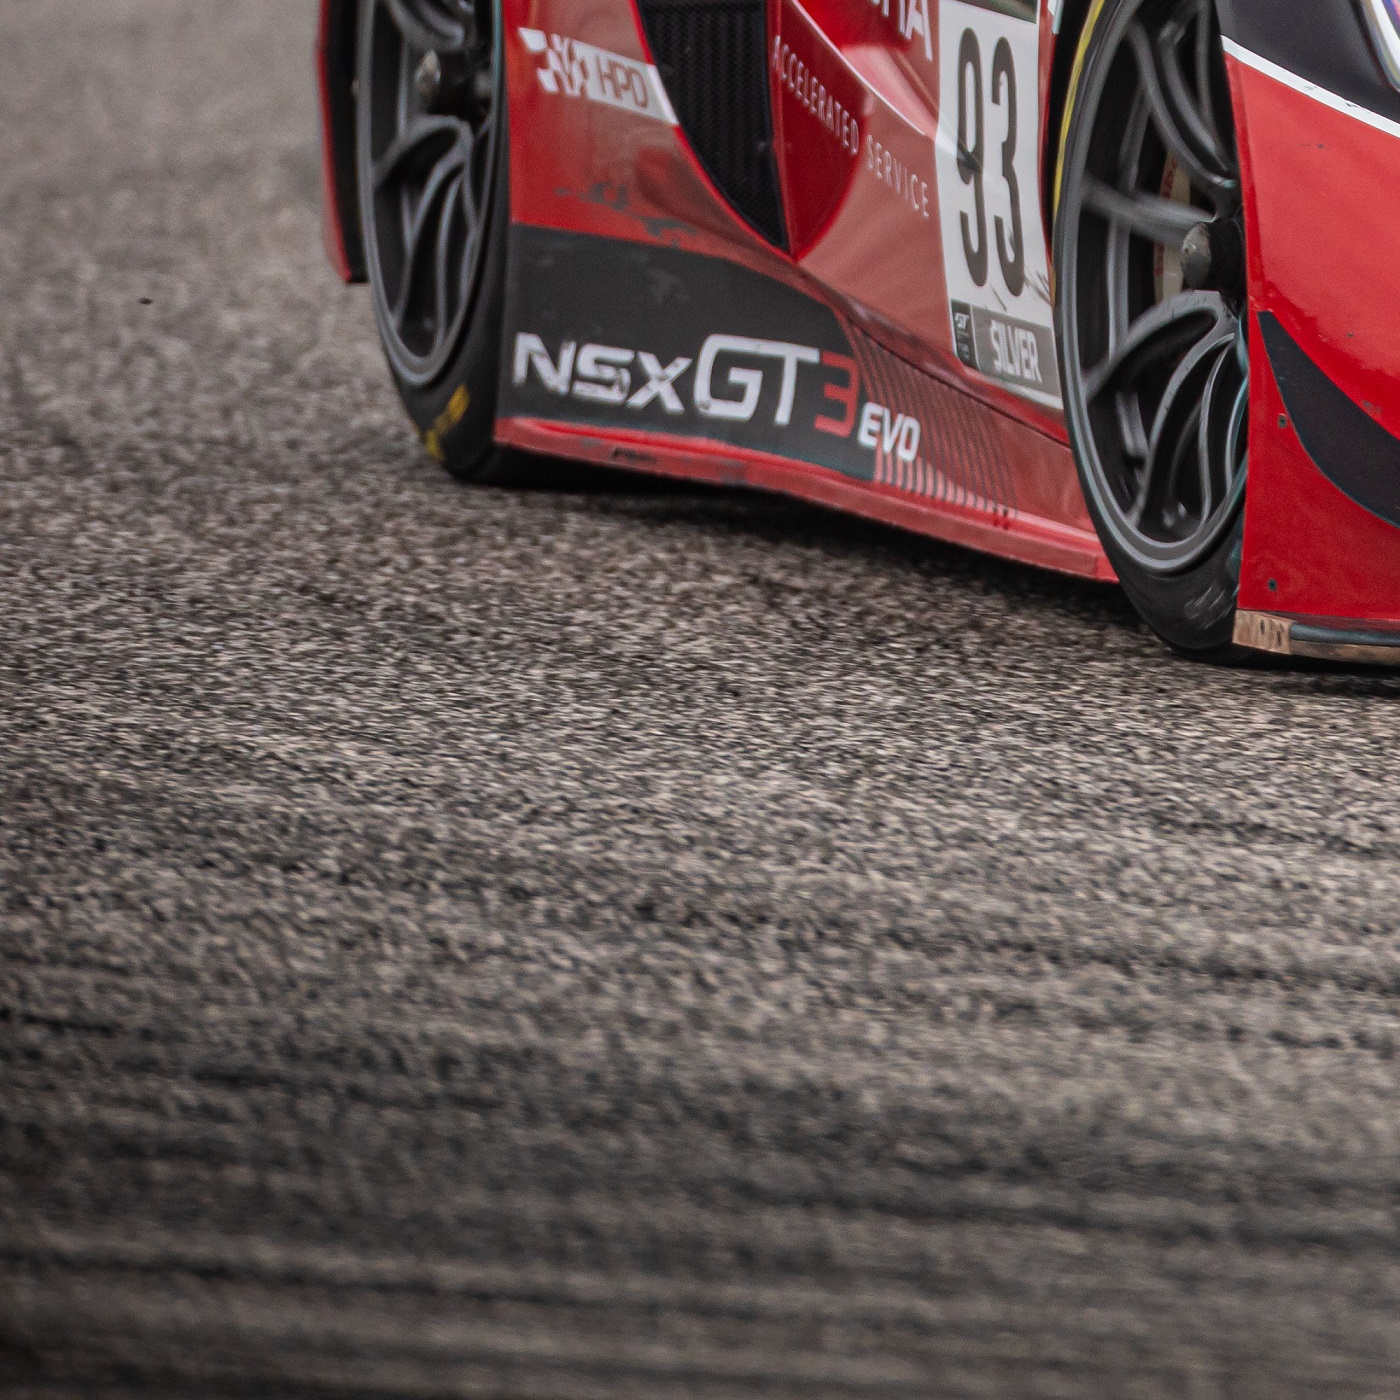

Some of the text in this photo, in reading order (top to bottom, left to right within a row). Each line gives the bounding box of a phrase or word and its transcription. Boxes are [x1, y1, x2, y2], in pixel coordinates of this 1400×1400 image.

[596, 53, 649, 109] HPD
[773, 34, 930, 218] ACCELERATED SERVICE
[956, 27, 1025, 298] 93
[990, 319, 1044, 384] SILVER
